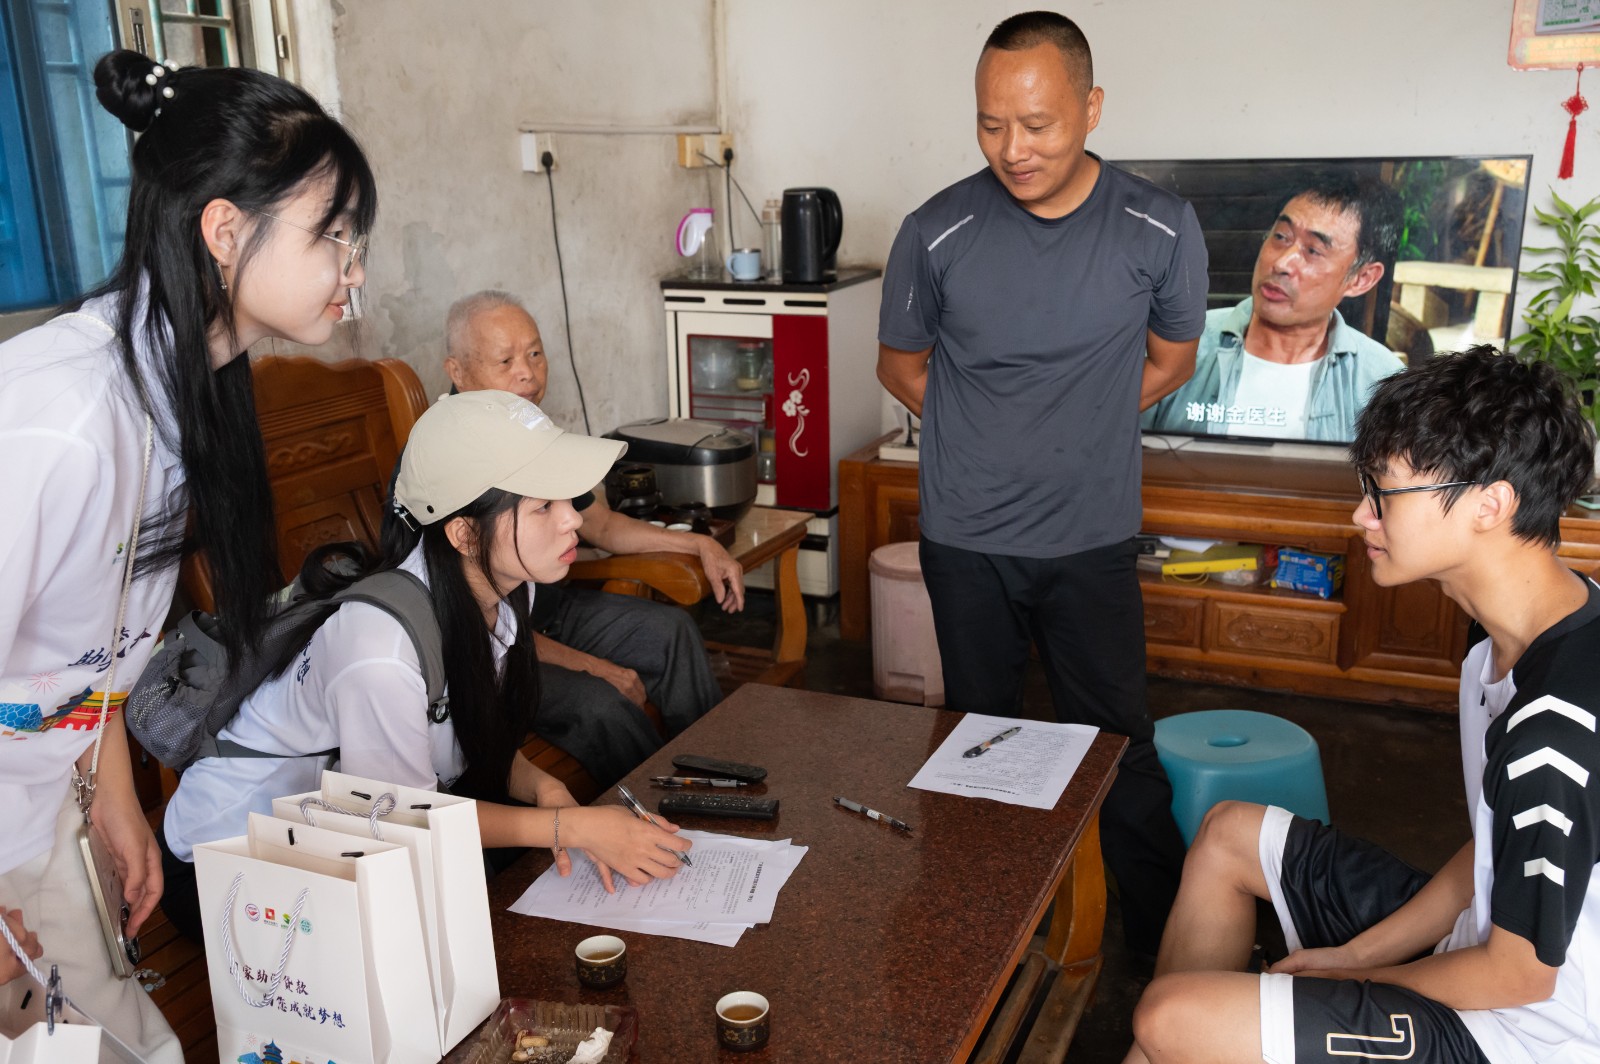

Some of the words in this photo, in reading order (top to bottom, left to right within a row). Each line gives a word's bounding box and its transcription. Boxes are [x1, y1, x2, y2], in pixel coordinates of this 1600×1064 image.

[1186, 401, 1286, 426] 谢谢金医生
